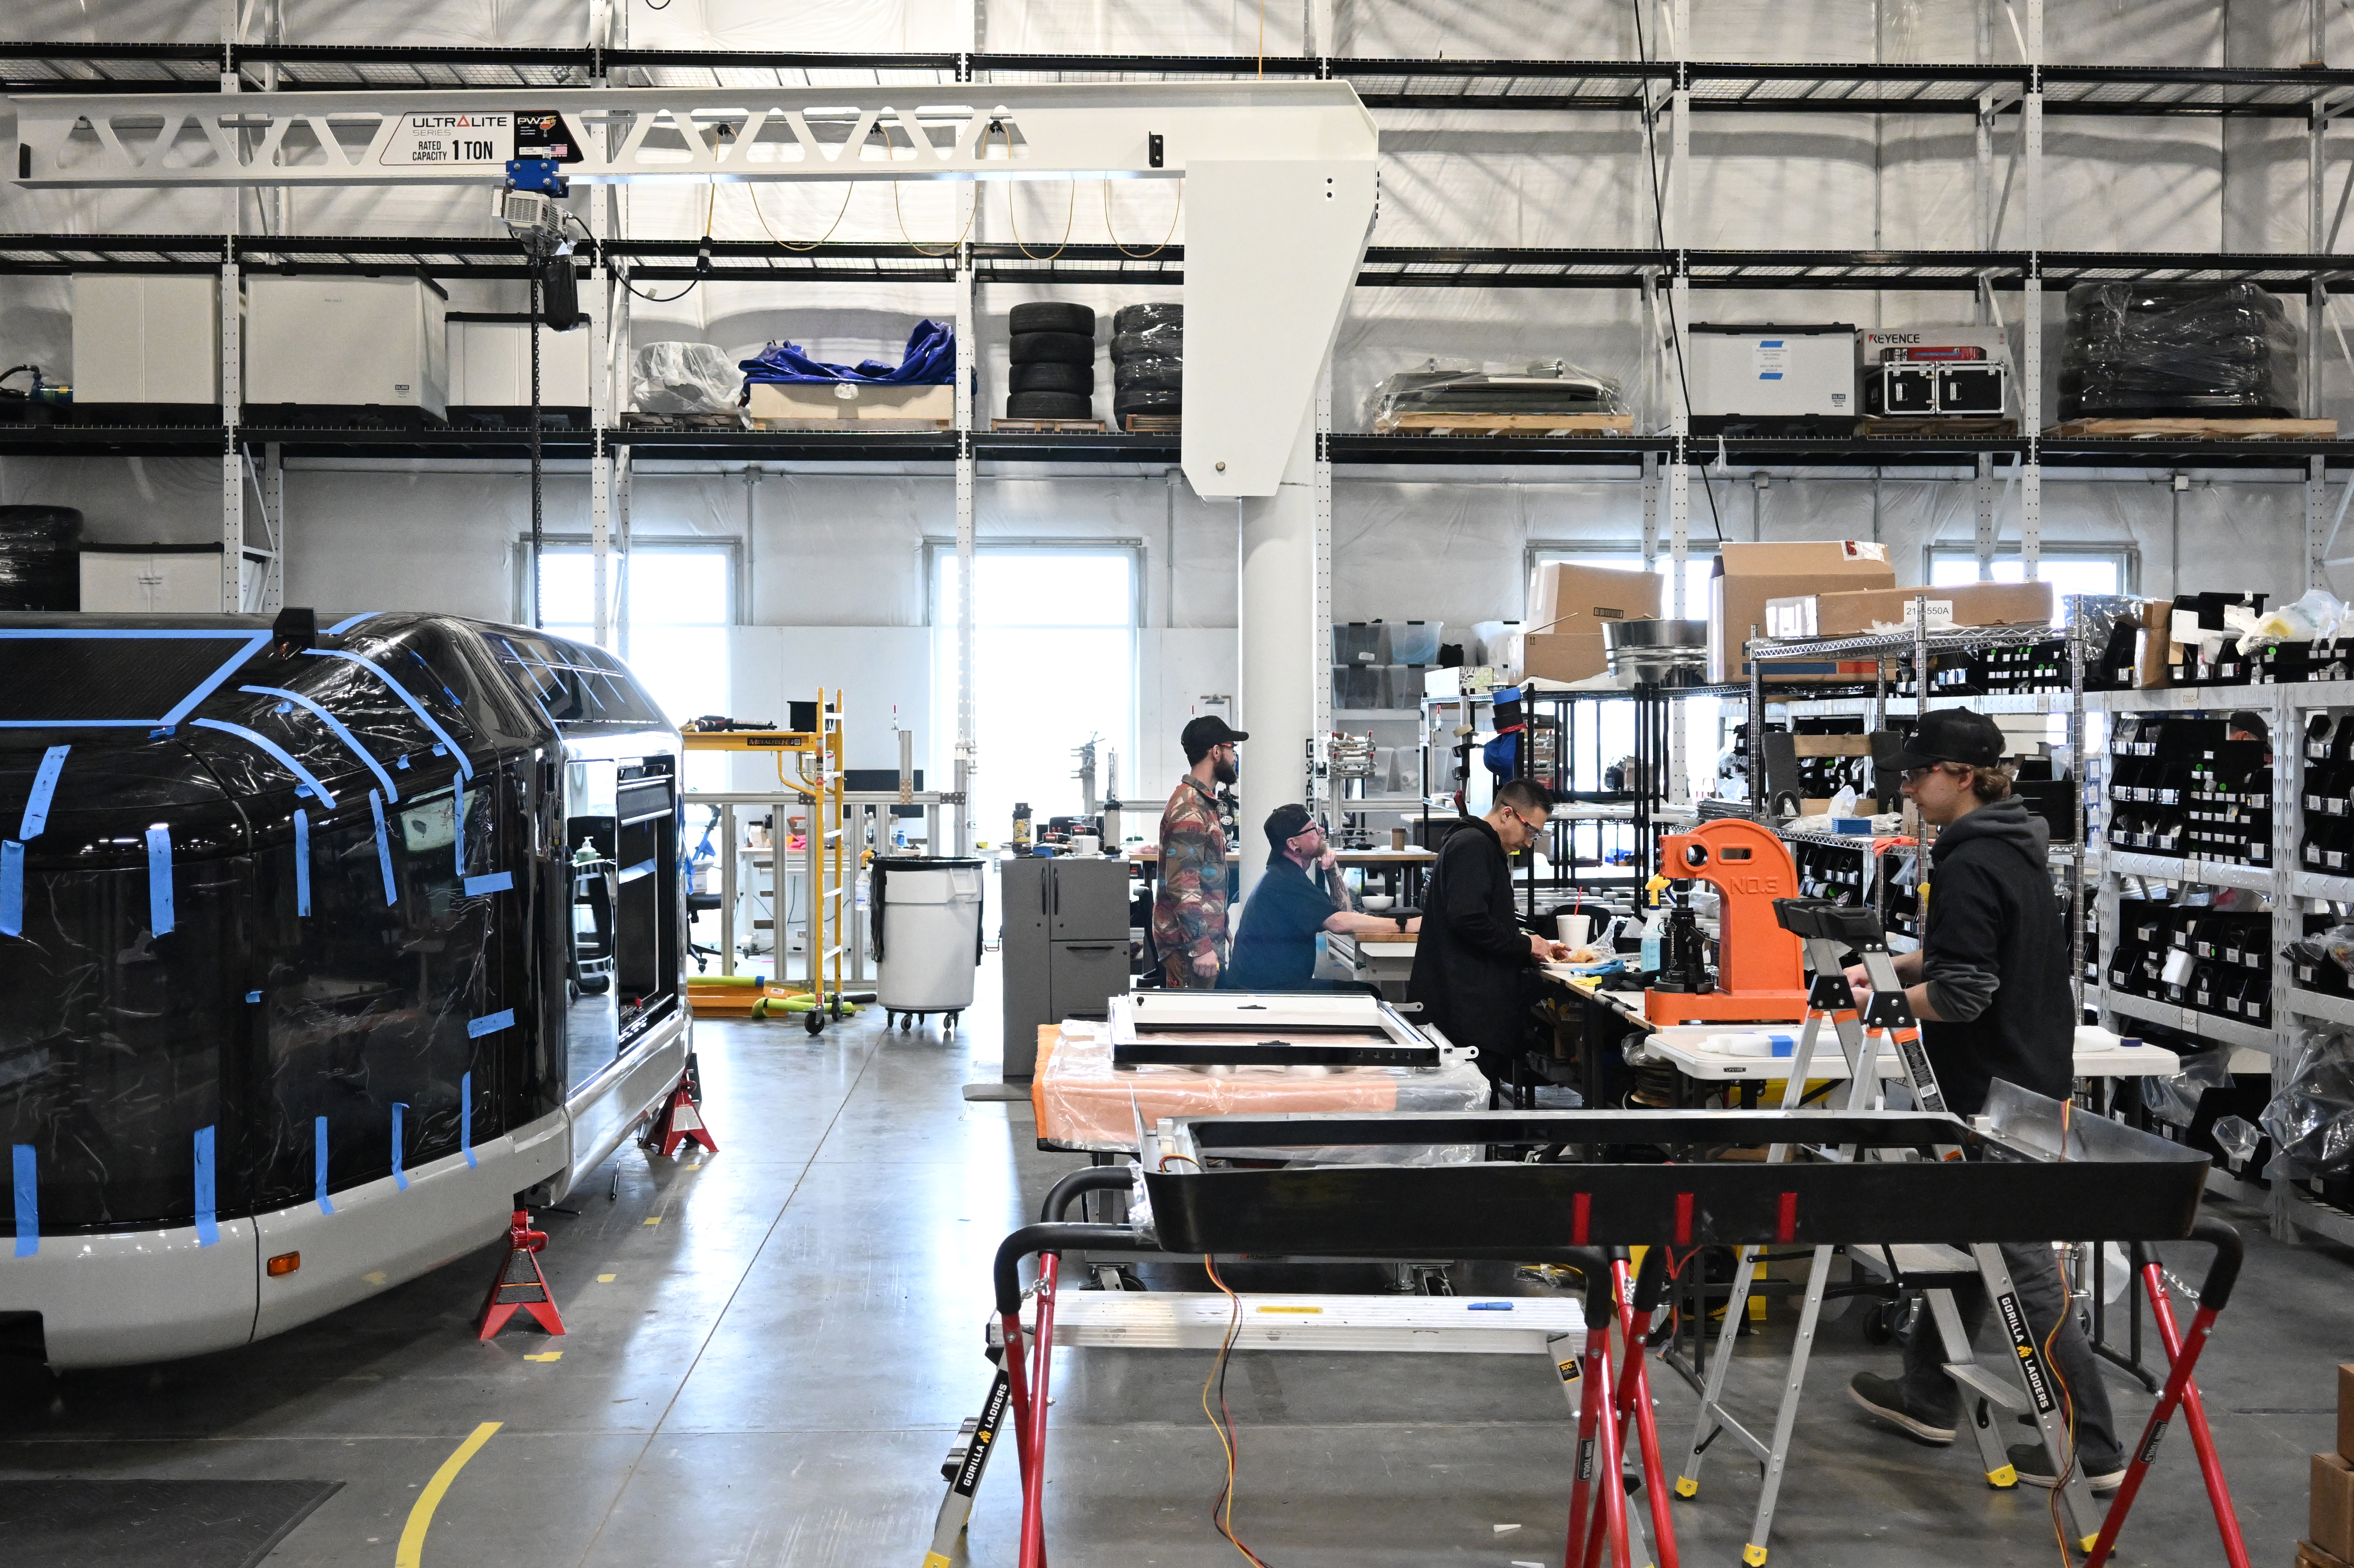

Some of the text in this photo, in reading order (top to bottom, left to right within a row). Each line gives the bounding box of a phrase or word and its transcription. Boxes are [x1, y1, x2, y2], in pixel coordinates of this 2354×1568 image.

[413, 115, 507, 127] ULTRALITE
[418, 141, 441, 151] RATED
[452, 140, 493, 160] 1 TON
[413, 151, 447, 161] CAPACITY
[1869, 334, 1920, 344] KEYENCE
[1730, 877, 1779, 894] NO.3
[2001, 1296, 2049, 1409] GORILLA LADDERS
[1560, 1363, 1573, 1371] 300
[963, 1383, 1008, 1487] GORILLA LADDERS
